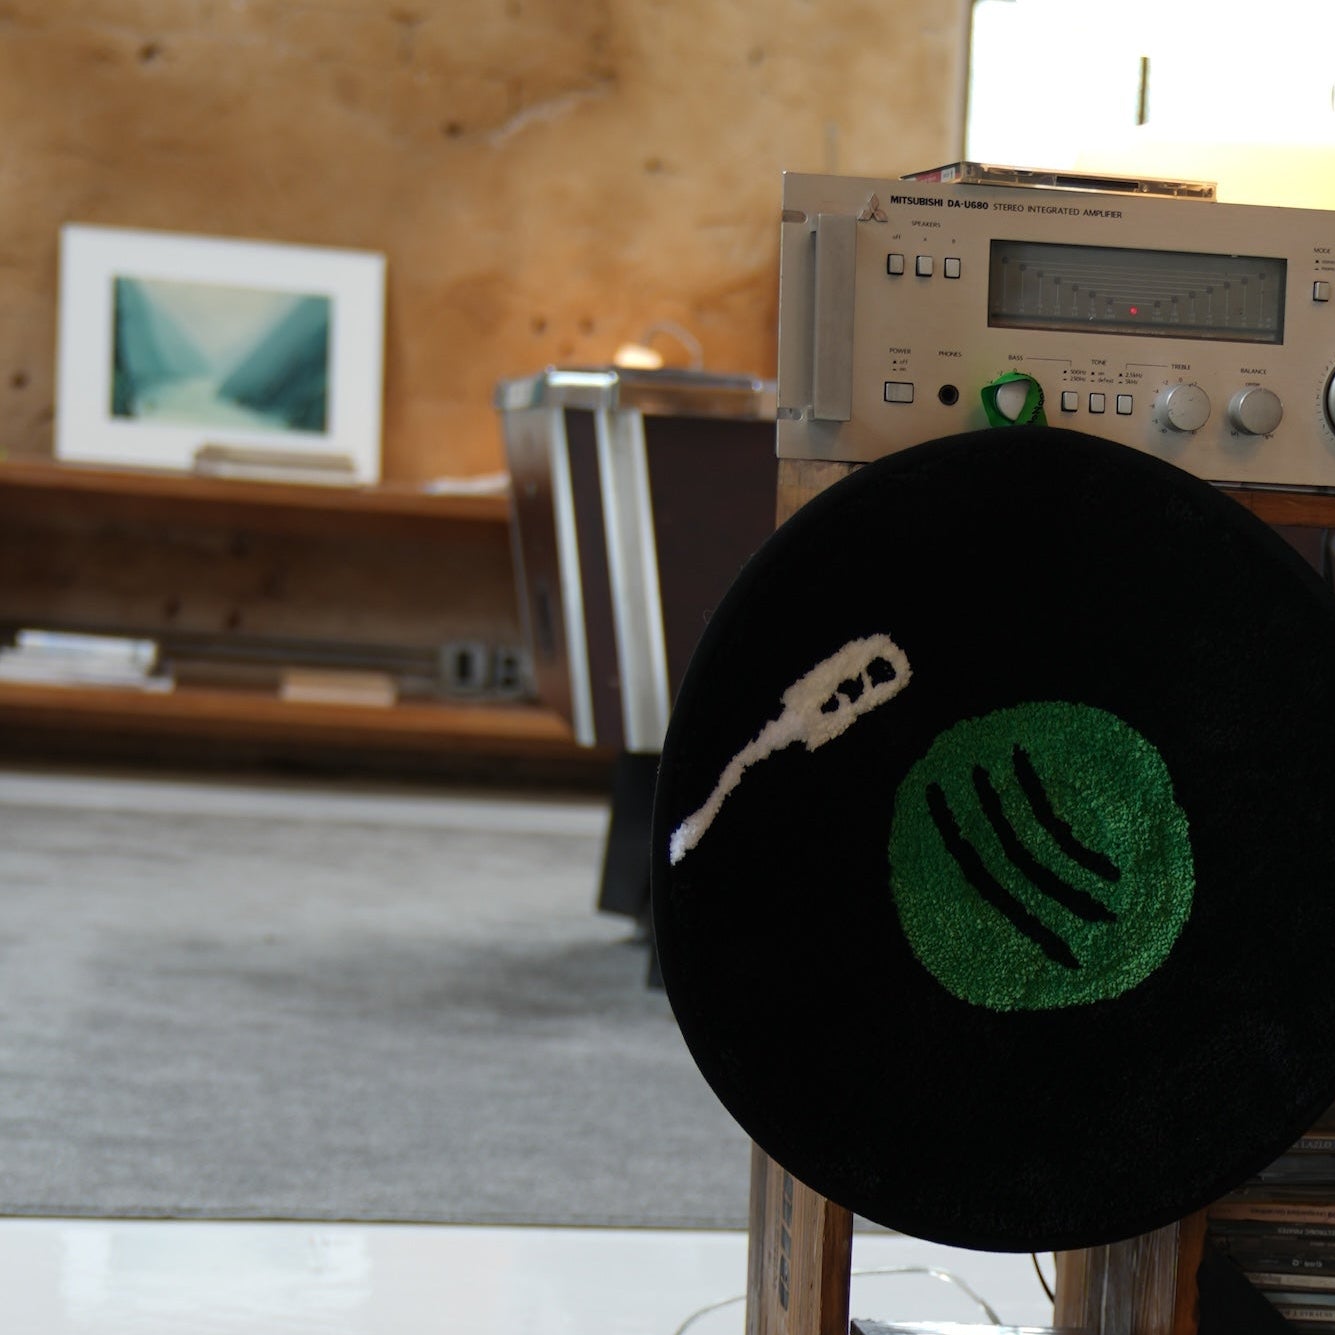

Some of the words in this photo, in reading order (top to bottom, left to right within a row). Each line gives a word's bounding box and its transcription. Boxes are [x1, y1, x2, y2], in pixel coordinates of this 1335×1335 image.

[890, 195, 943, 208] MITSUBISHI
[948, 199, 988, 211] DA-U680
[993, 203, 1023, 213] STEREO
[1027, 205, 1079, 216] INTEGRATED
[1083, 208, 1122, 219] AMPLIFIER
[1008, 354, 1024, 362] BASS
